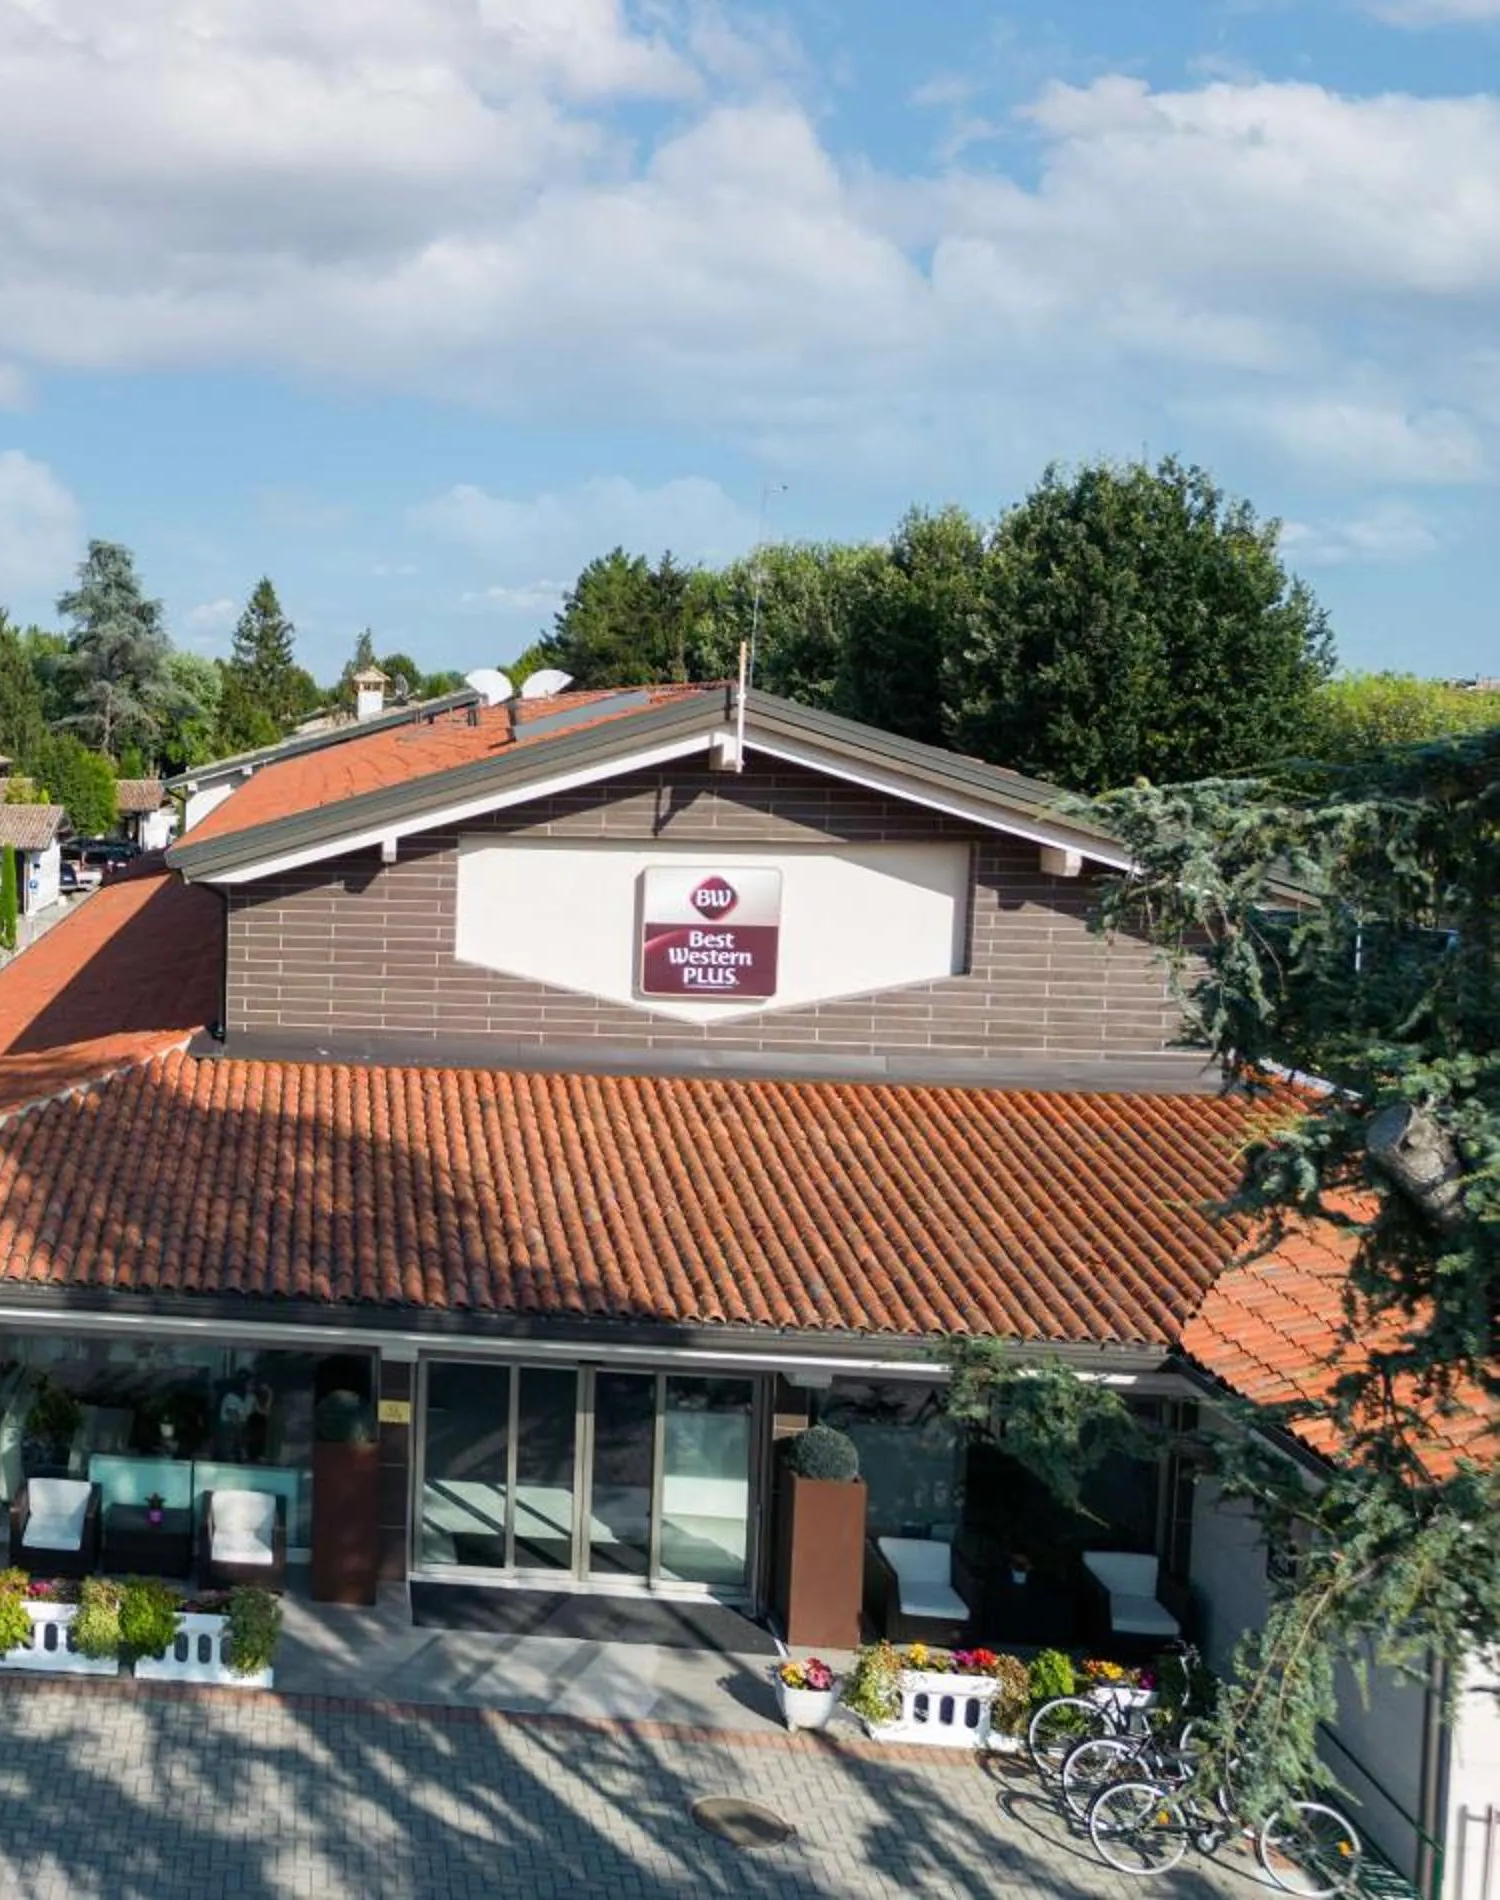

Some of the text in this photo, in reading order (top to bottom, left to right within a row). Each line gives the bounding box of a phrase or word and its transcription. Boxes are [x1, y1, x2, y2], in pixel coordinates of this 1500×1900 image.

[689, 931, 735, 948] Best
[668, 947, 752, 966] Western
[683, 967, 736, 985] PLUS
